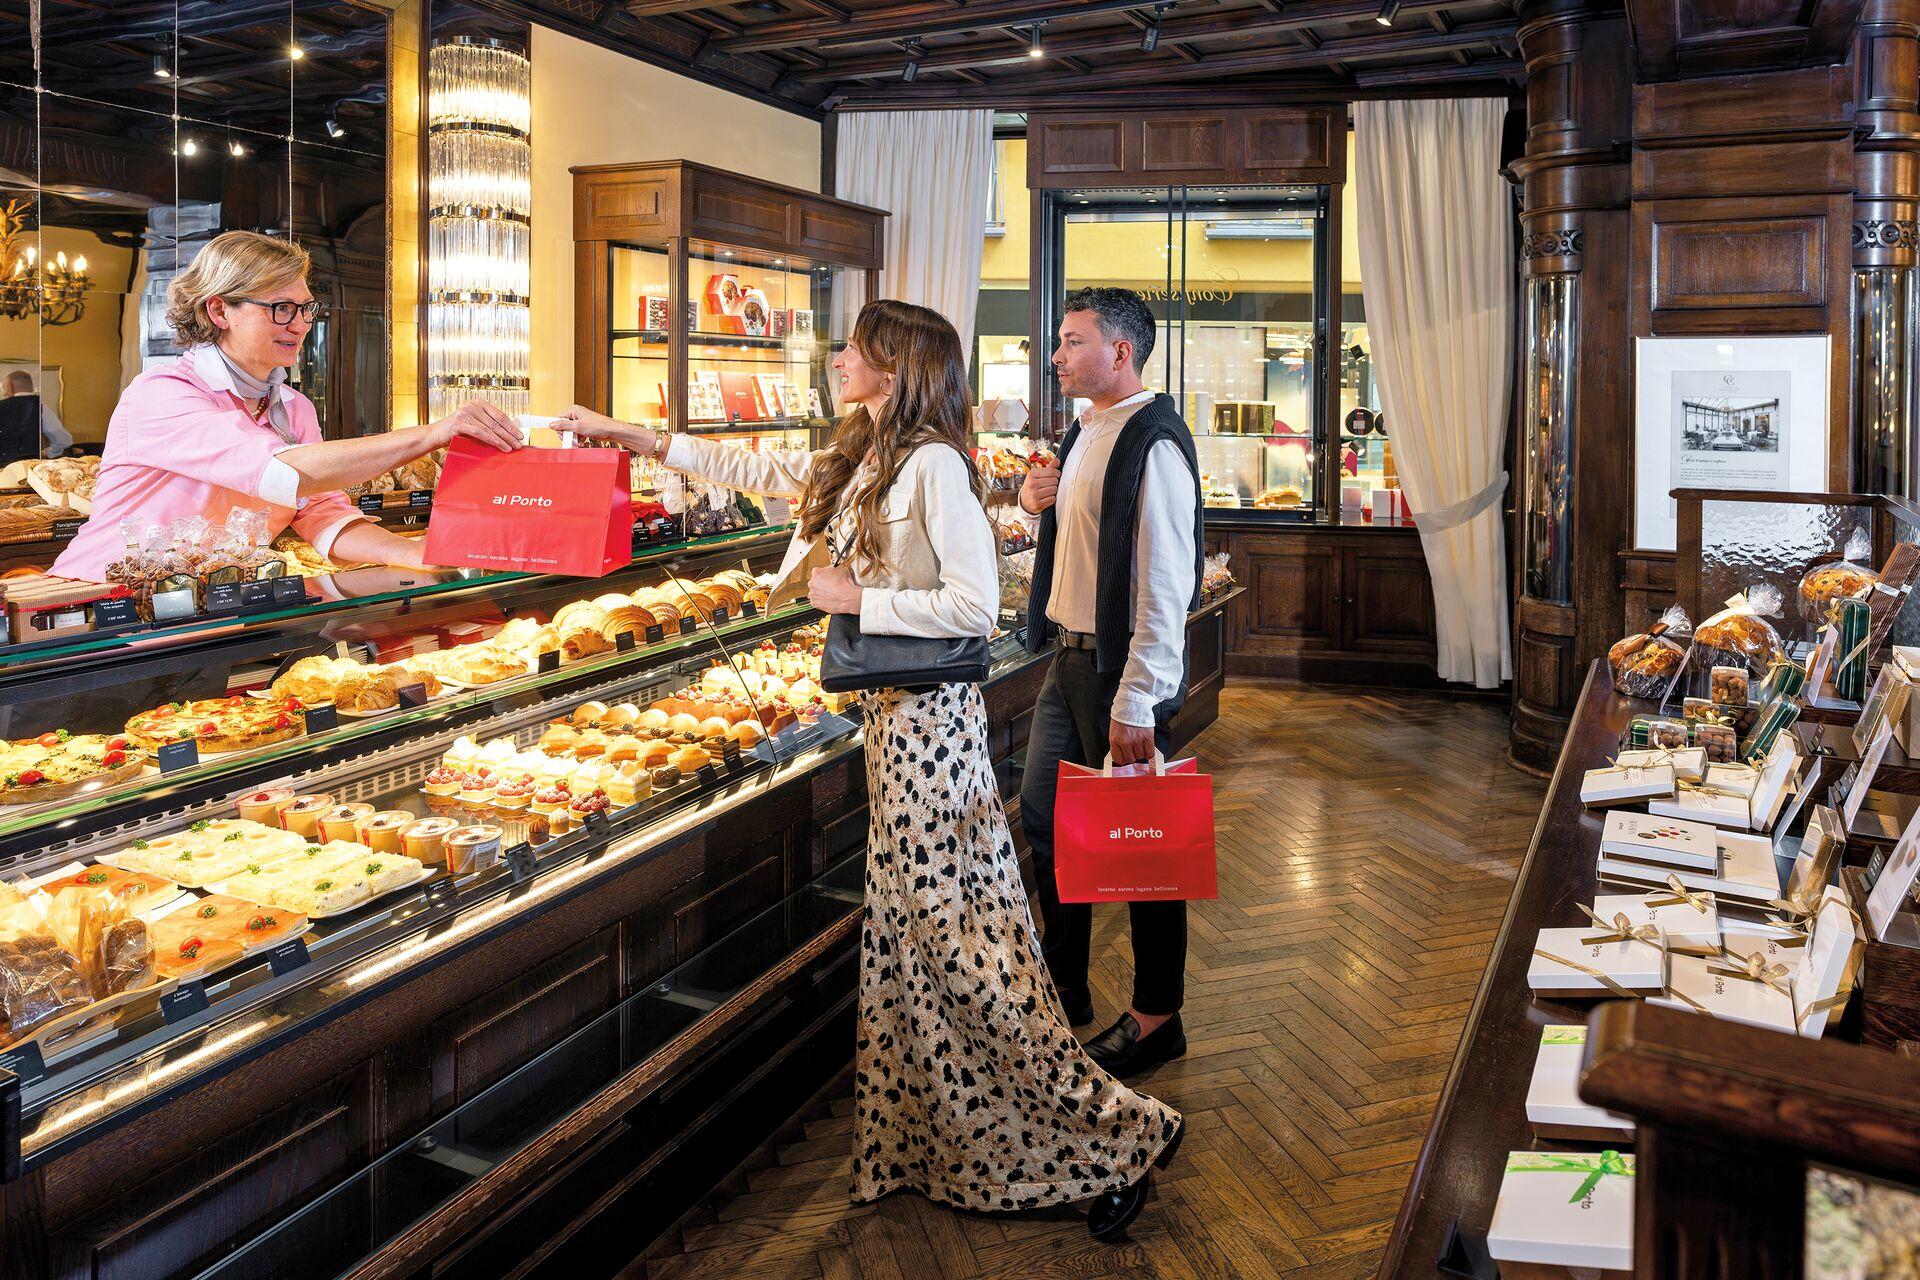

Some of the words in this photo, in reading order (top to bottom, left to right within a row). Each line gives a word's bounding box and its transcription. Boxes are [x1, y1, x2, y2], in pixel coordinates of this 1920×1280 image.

[492, 494, 507, 505] al
[510, 495, 552, 507] Porto
[1109, 827, 1121, 839] al
[1124, 827, 1163, 839] Porto
[1715, 981, 1725, 995] Porto
